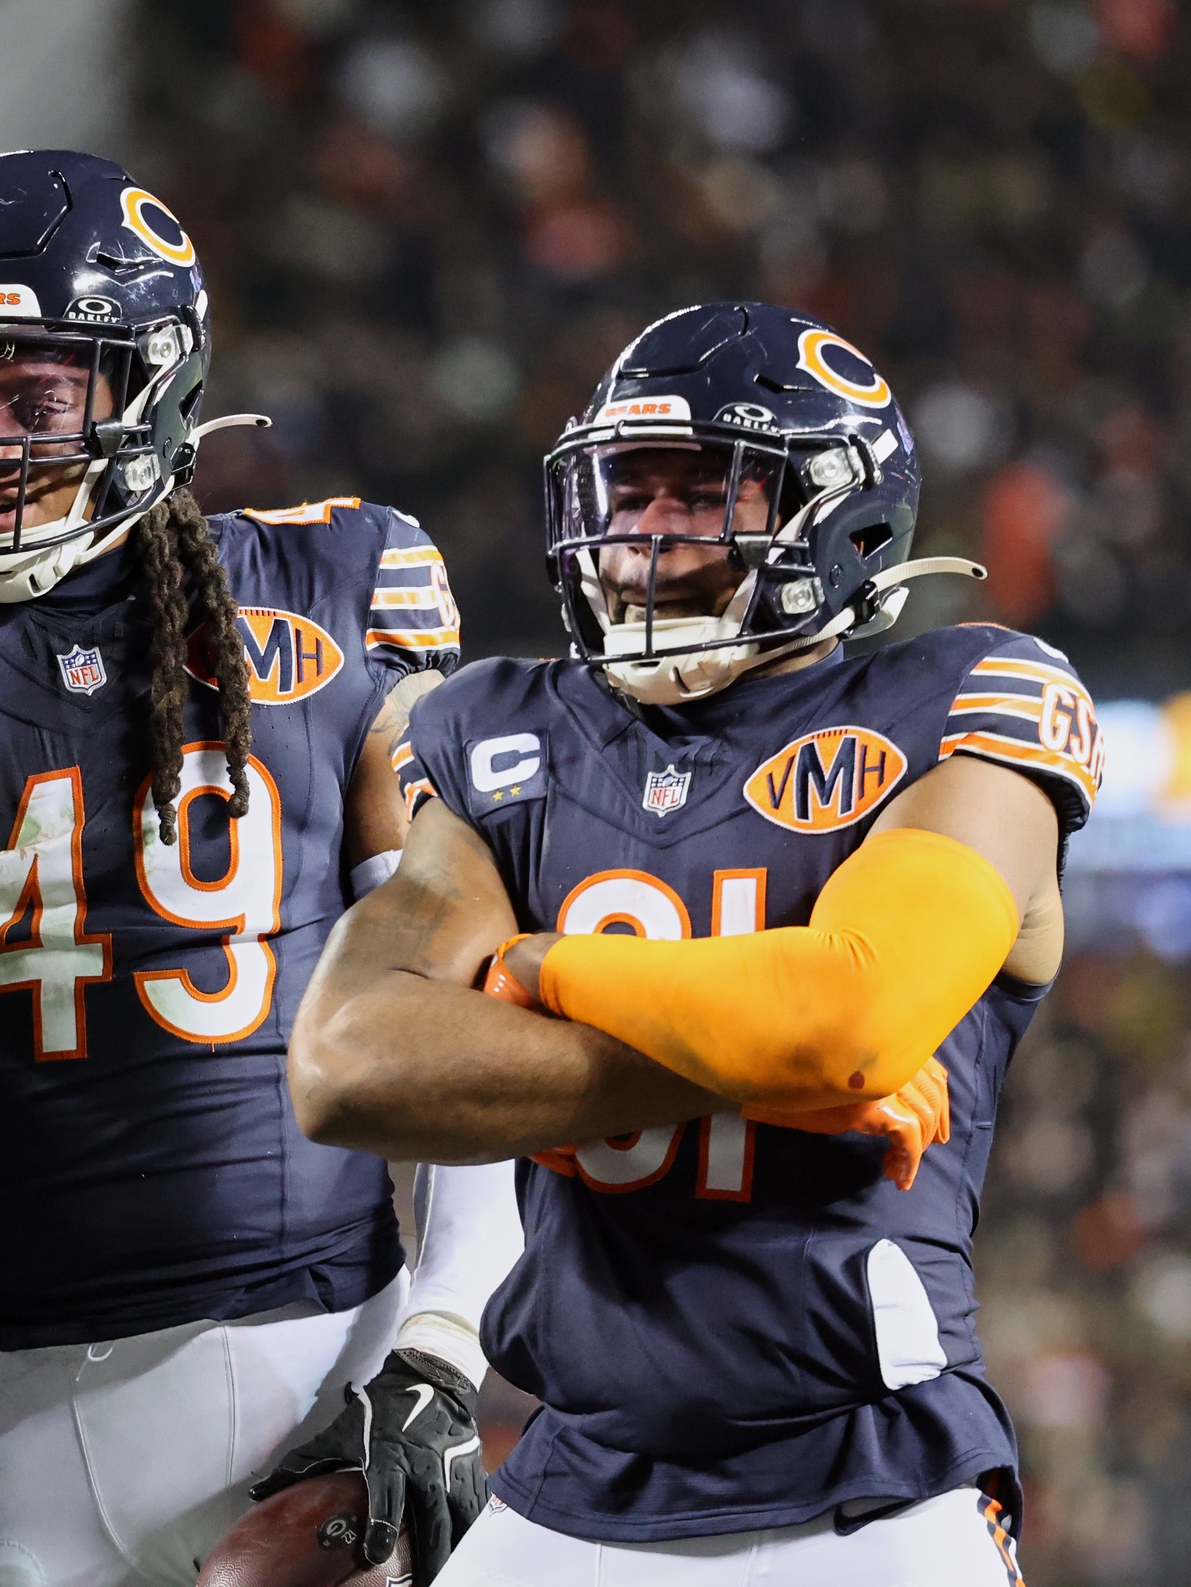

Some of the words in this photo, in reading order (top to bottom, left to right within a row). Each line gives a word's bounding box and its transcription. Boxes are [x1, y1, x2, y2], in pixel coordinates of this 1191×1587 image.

[68, 311, 117, 324] OAKLEY
[69, 665, 100, 686] NFL
[234, 616, 323, 695] MH
[471, 733, 540, 792] C
[767, 734, 886, 823] VMH
[651, 789, 679, 807] NFL
